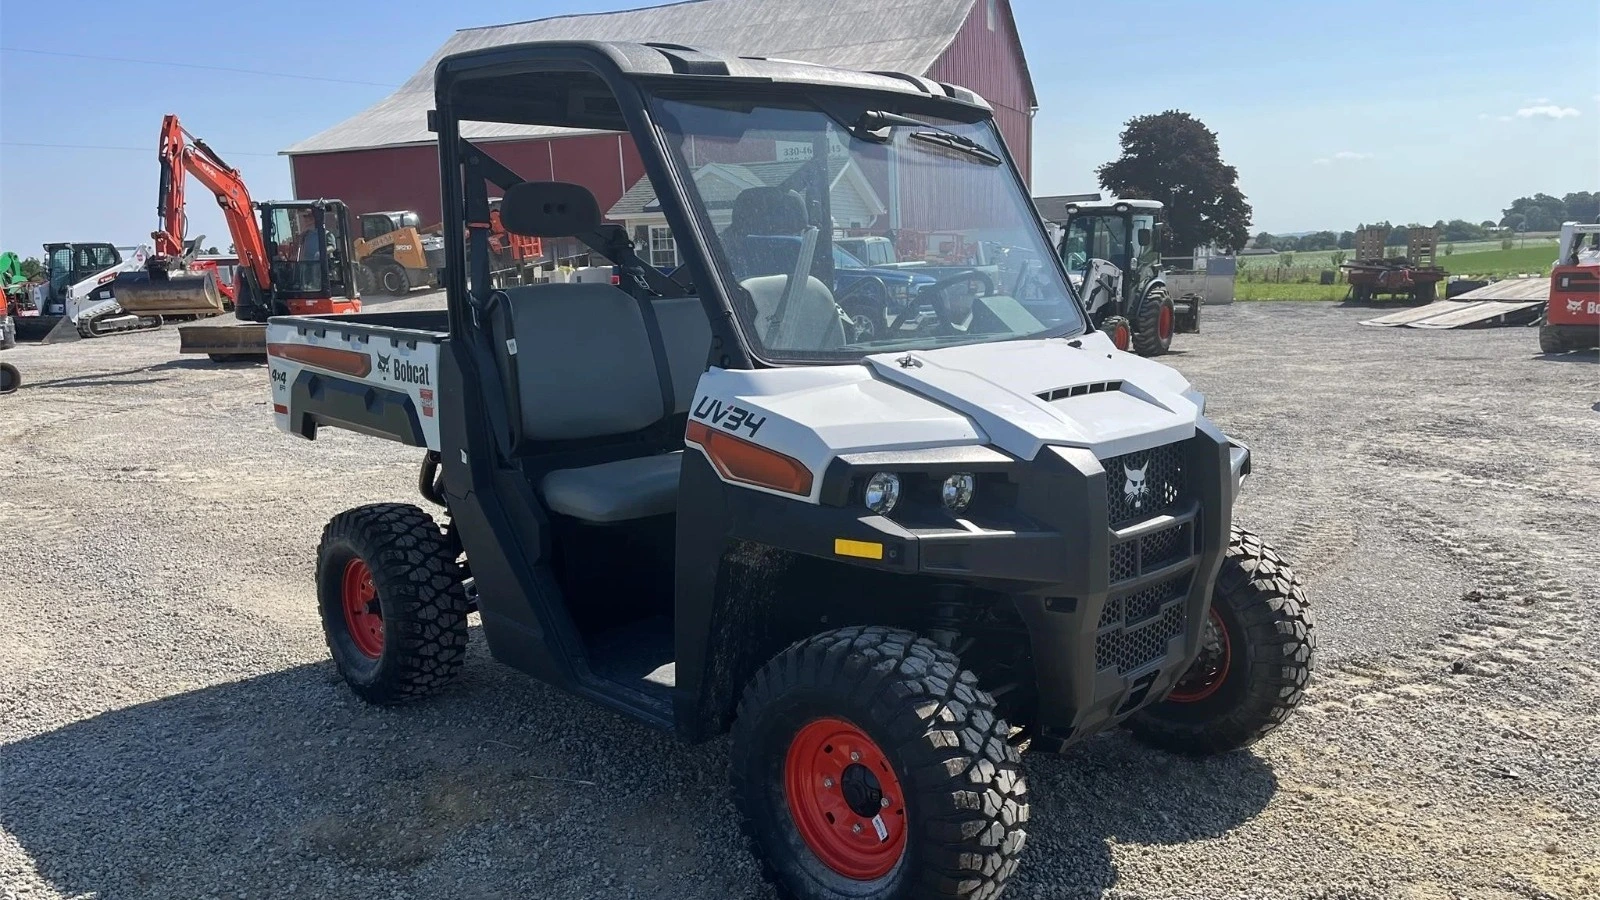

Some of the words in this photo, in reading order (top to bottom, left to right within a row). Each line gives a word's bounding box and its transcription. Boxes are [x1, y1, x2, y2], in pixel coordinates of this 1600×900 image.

[272, 369, 287, 384] 4x4
[394, 358, 430, 386] Bobcat
[693, 396, 766, 438] UV34
